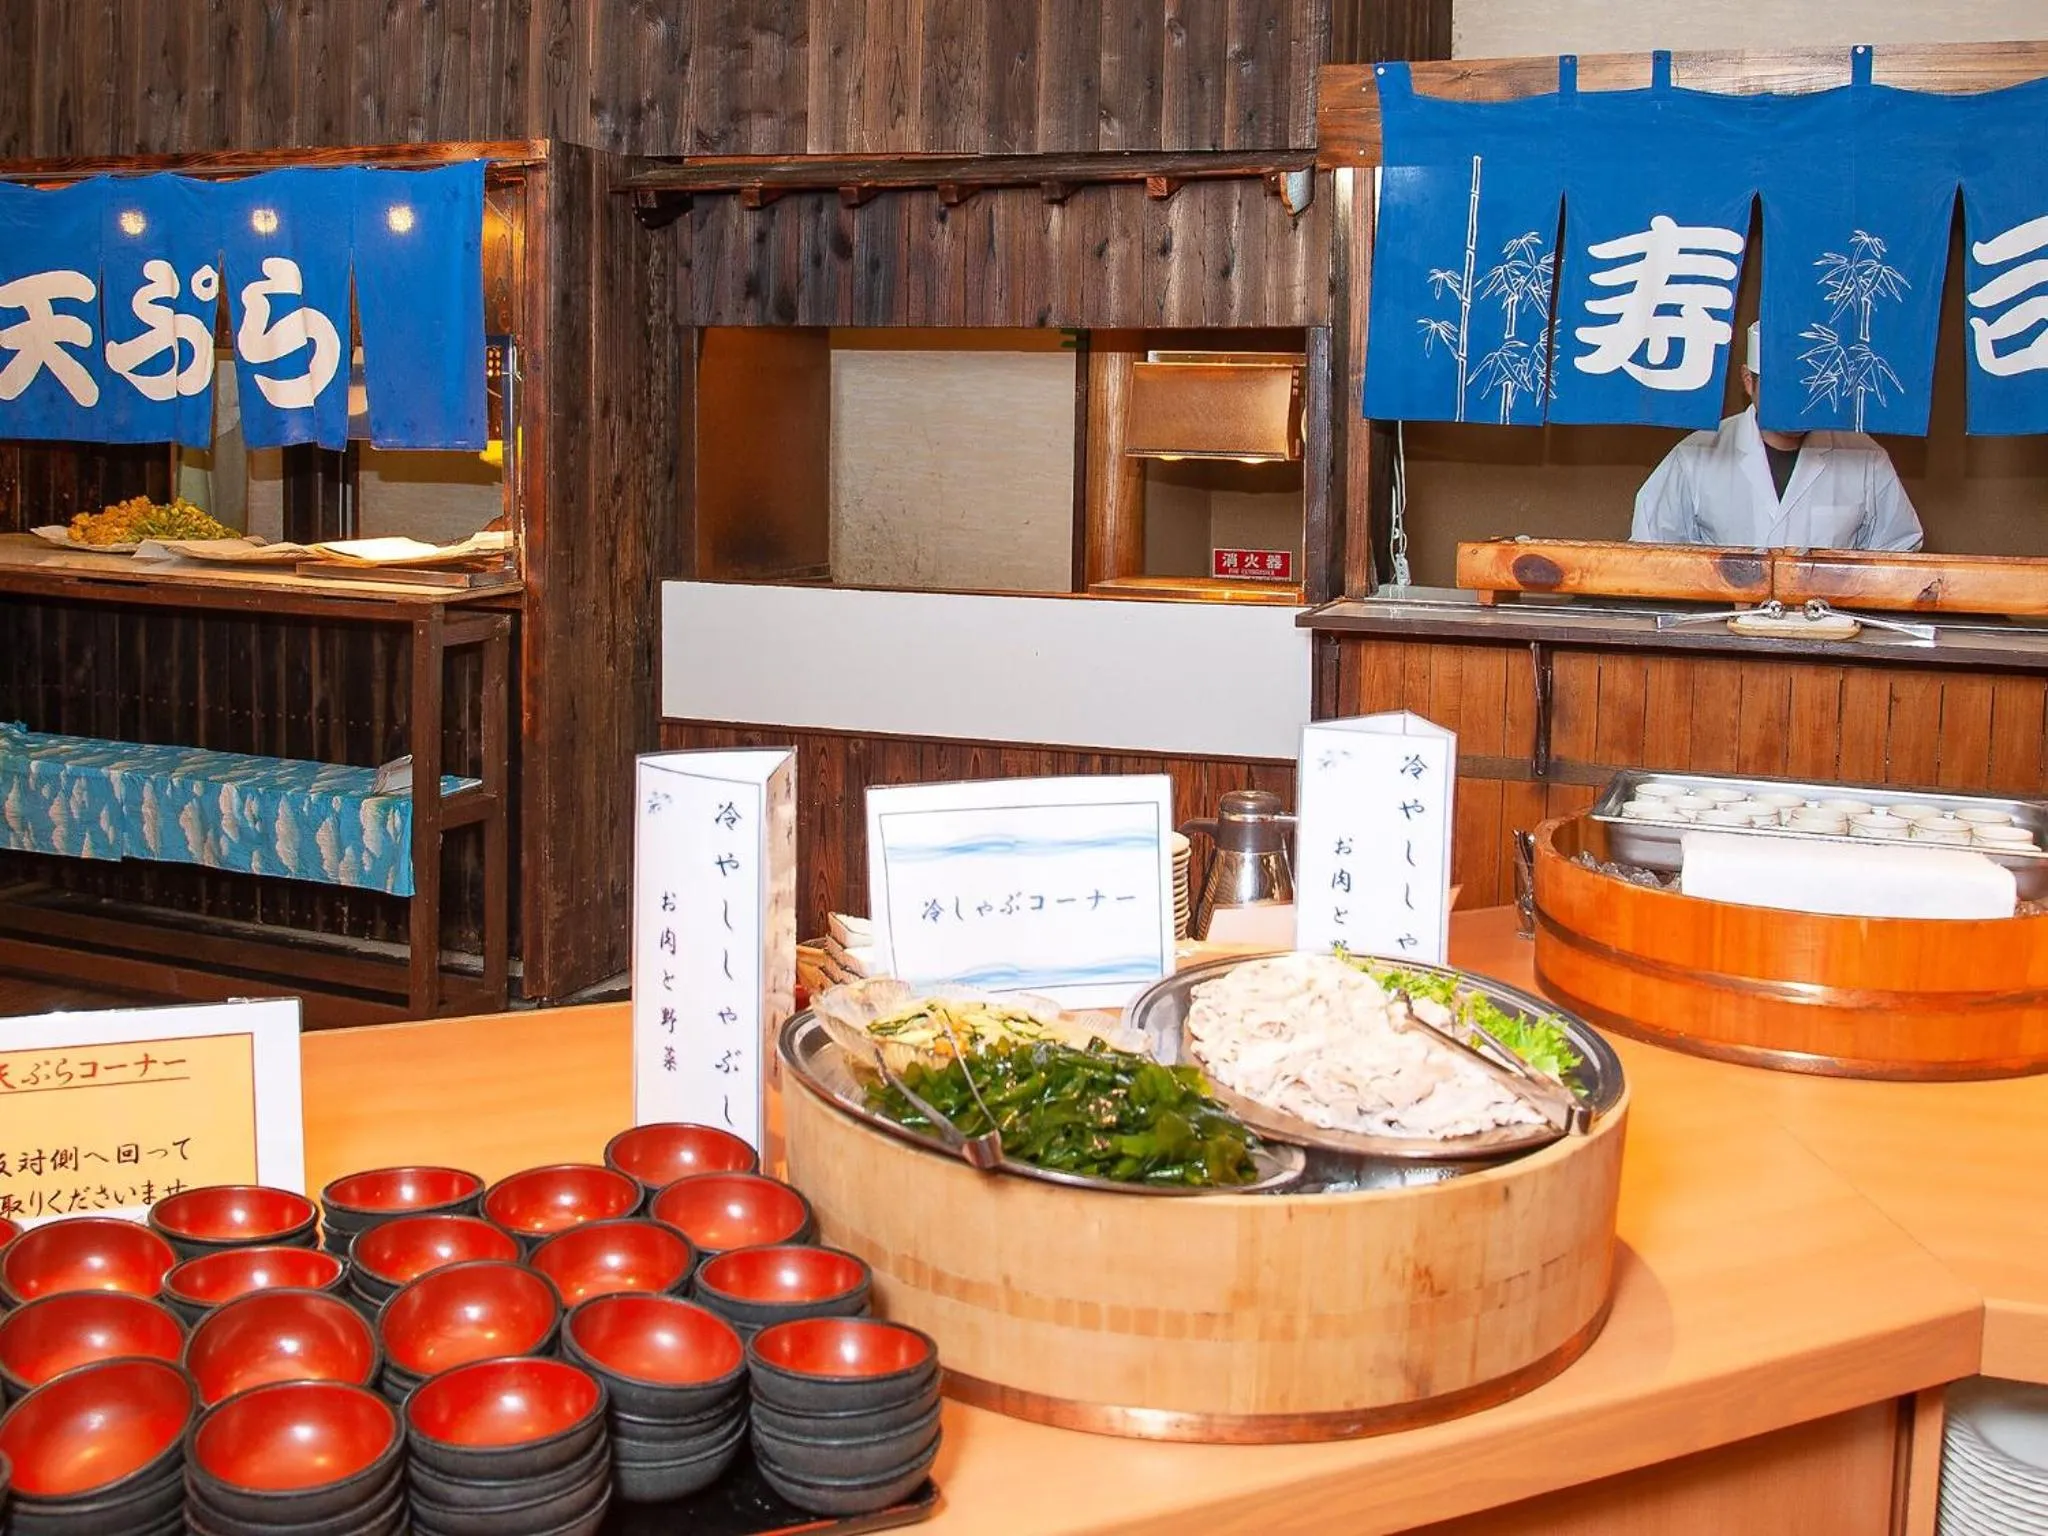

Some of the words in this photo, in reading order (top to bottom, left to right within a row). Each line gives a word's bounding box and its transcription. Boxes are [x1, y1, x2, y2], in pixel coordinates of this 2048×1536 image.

[0, 257, 341, 409] 天ぷら
[1221, 552, 1283, 569] 消火器
[659, 891, 678, 1072] お肉と野菜
